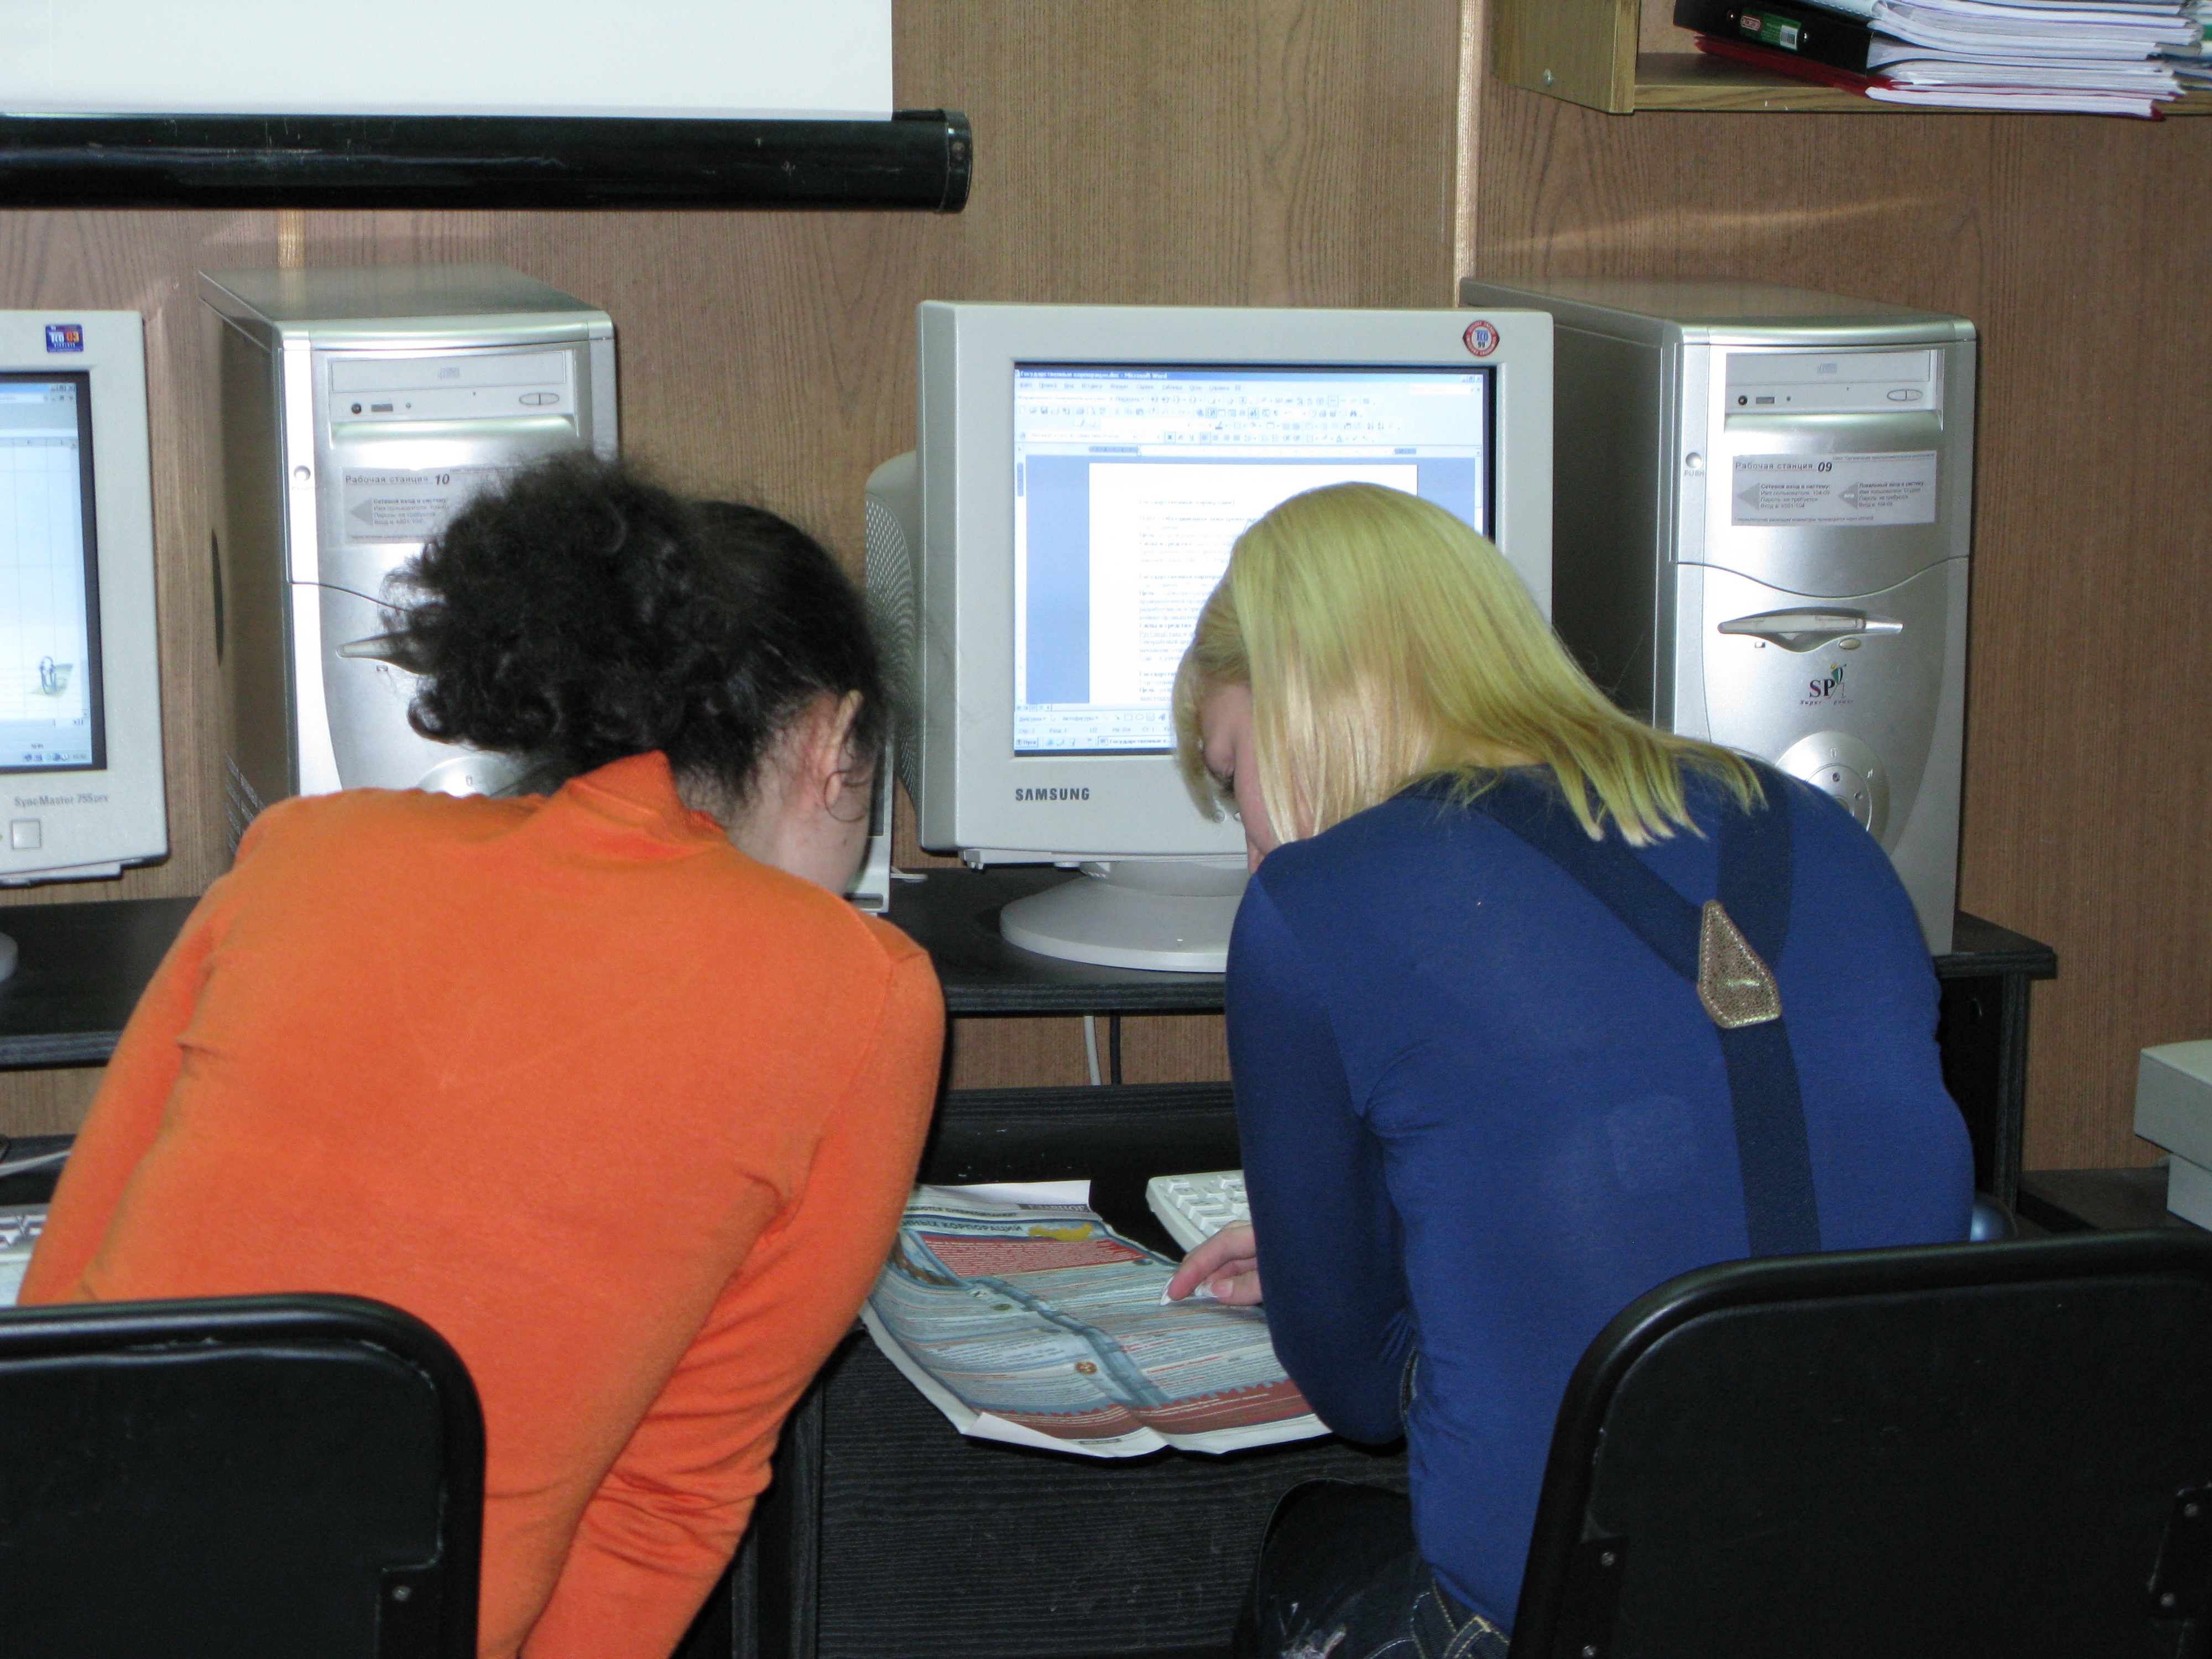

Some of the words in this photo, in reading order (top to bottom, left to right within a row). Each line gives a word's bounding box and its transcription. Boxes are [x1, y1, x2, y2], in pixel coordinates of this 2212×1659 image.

[1818, 462, 1832, 472] 09
[435, 474, 450, 484] 10
[1015, 787, 1090, 801] SAMSUNG
[15, 795, 74, 808] SyncMaster
